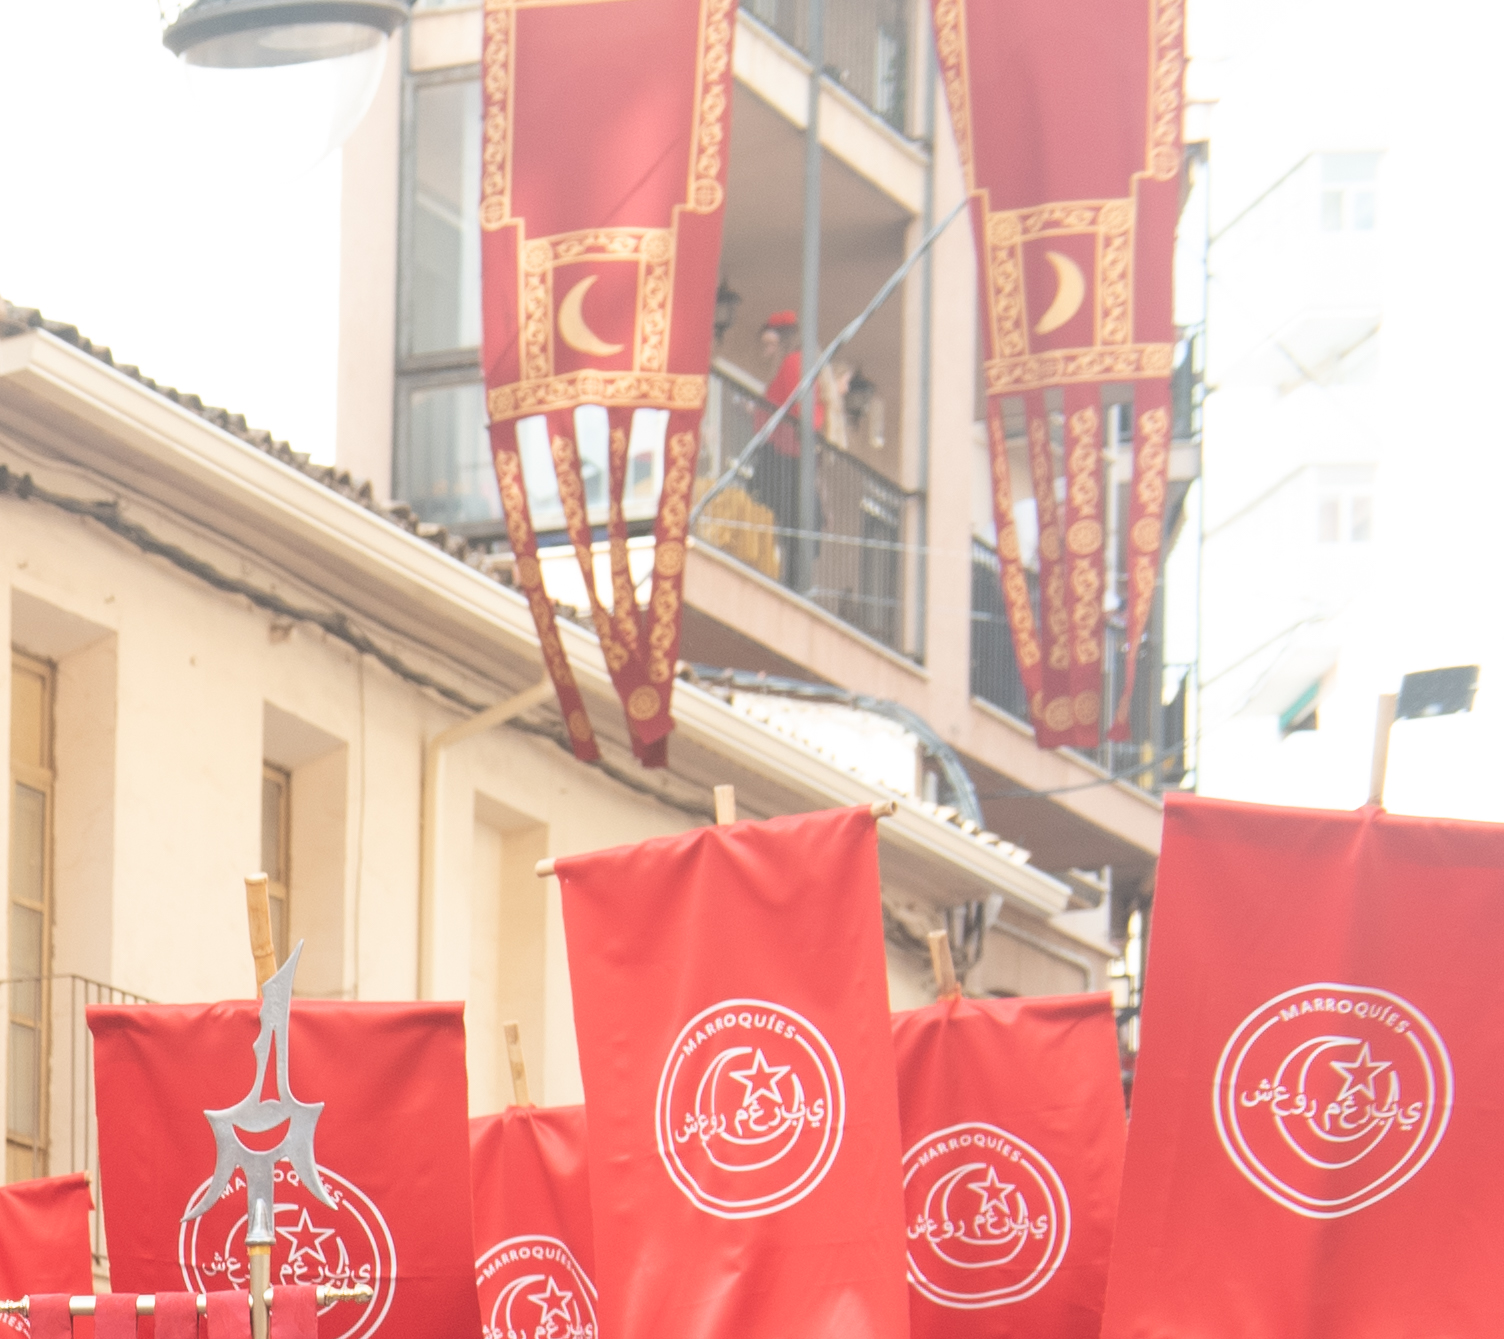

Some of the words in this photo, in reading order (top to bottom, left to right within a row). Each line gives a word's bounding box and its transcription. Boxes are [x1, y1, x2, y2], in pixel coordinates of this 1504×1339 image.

[1280, 997, 1410, 1034] MARROQUÍES
[682, 1011, 796, 1057] MARROQUÍES
[917, 1133, 1022, 1167] MARROQUÍES
[220, 1169, 344, 1204] MAOQES
[482, 1245, 573, 1280] MARROQUÍES
